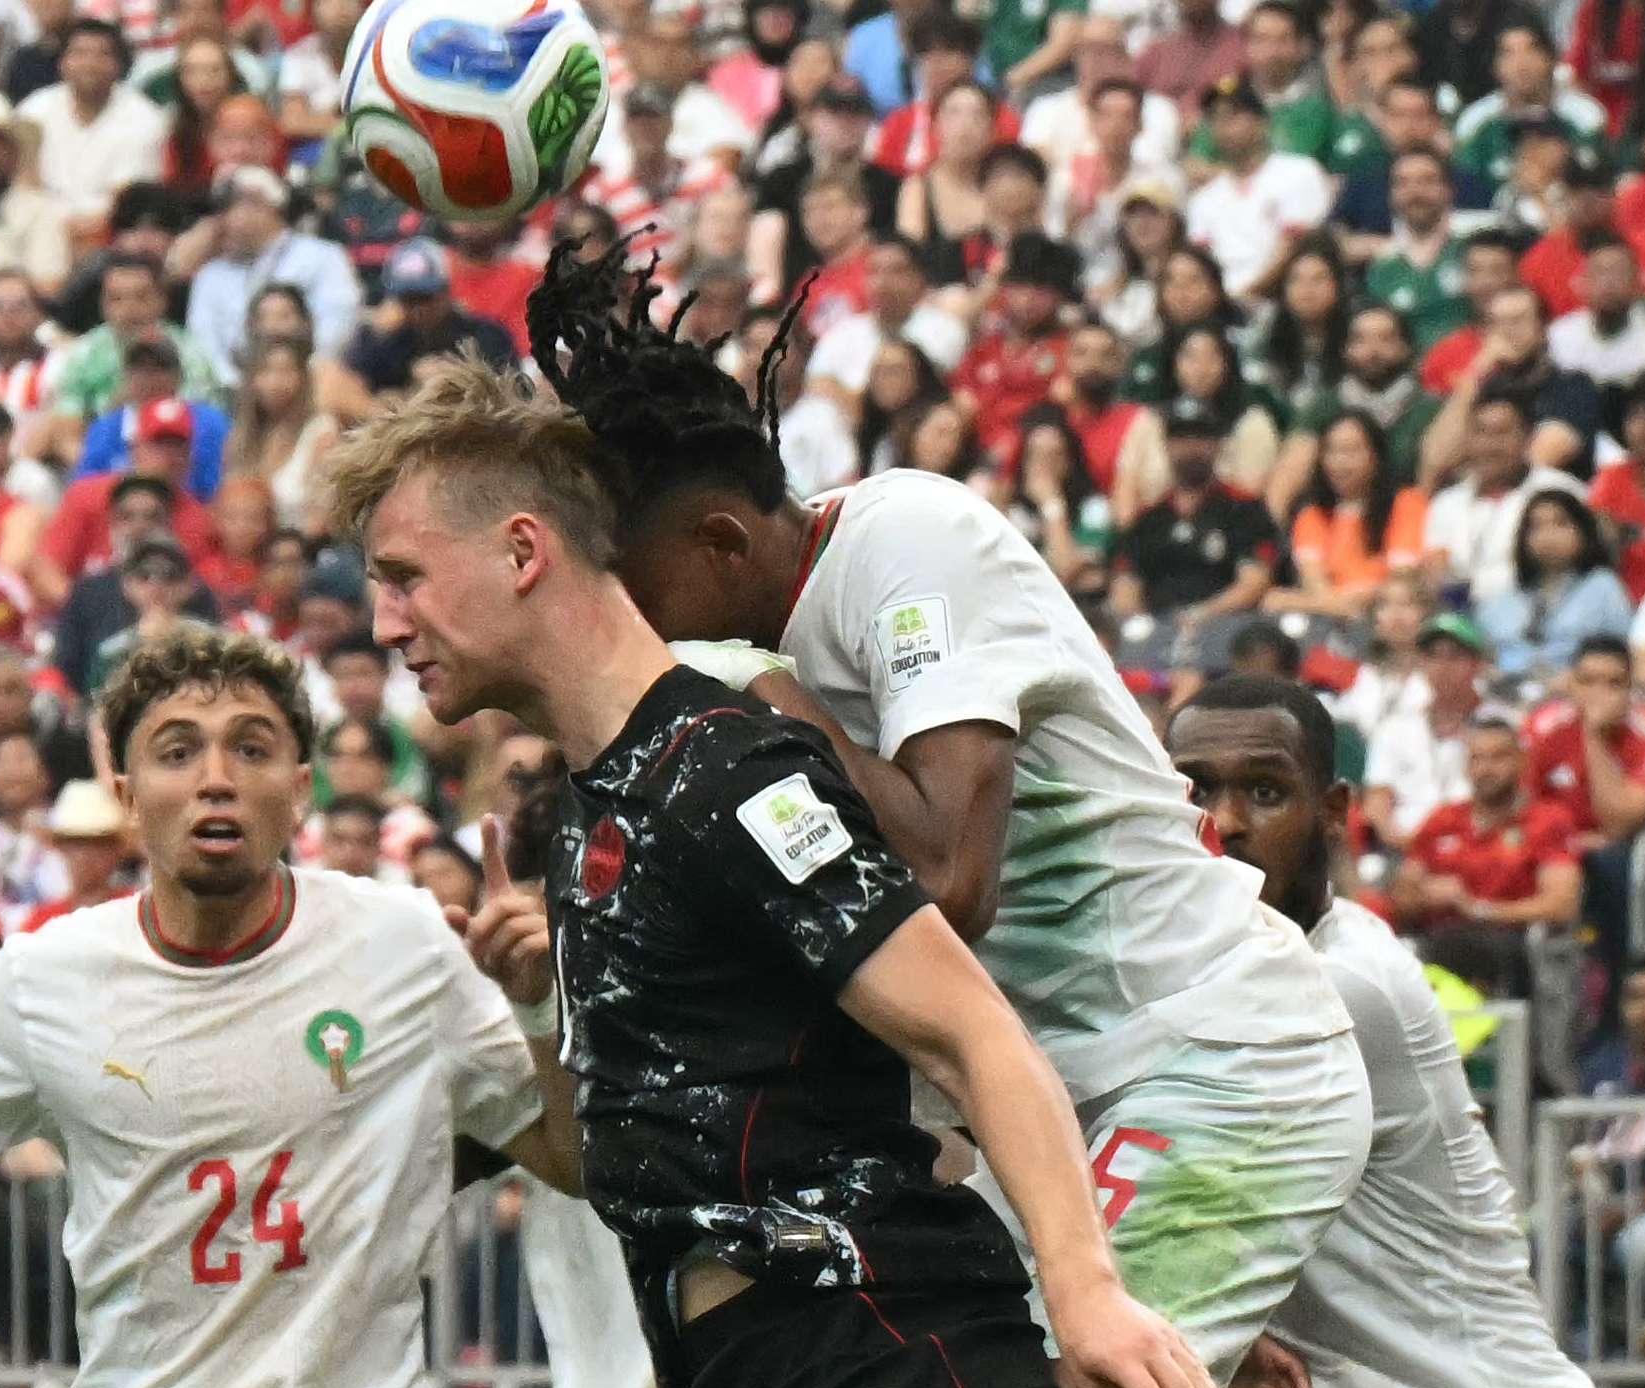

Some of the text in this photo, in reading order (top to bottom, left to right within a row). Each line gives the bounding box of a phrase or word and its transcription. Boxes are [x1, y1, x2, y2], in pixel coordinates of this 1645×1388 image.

[890, 650, 941, 675] EDUCATION
[784, 822, 833, 860] EDUCATION
[187, 1151, 309, 1285] 24
